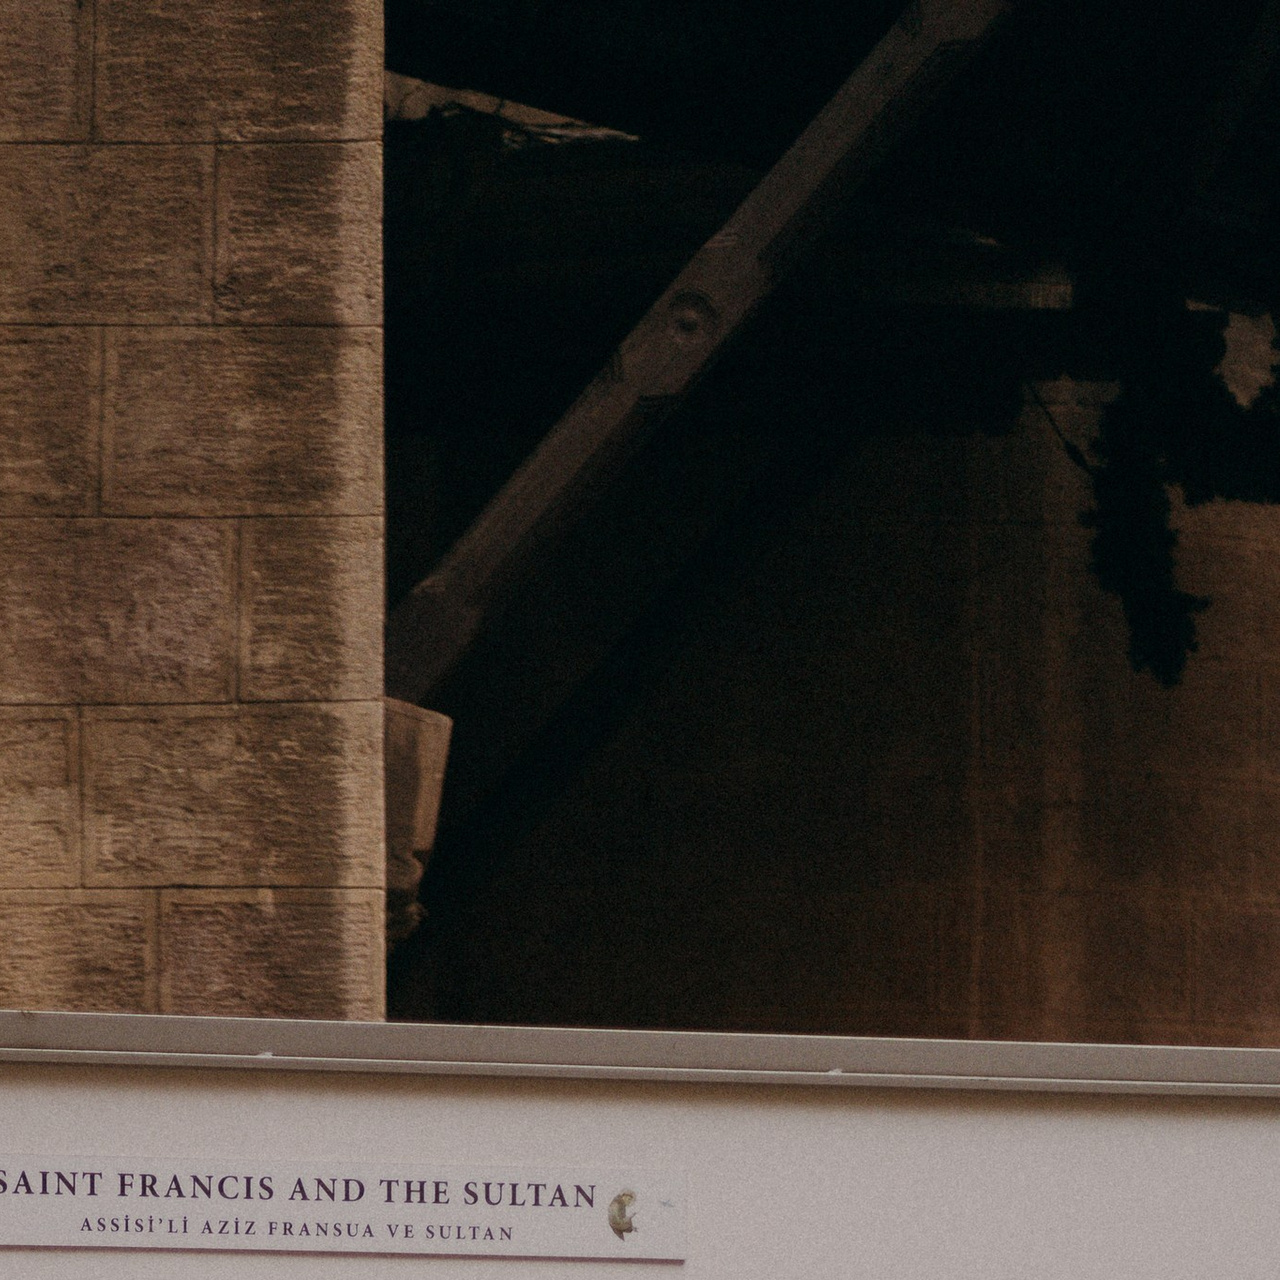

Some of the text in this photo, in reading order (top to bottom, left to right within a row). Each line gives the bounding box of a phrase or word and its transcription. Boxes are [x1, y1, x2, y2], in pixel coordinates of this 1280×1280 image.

[117, 1173, 274, 1200] FRANCIS
[288, 1177, 366, 1202] AND
[379, 1179, 451, 1204] THE
[463, 1181, 597, 1208] SULTAN
[201, 1217, 257, 1236] AZİZ
[268, 1221, 375, 1238] FRANSUA
[387, 1224, 414, 1239] VE
[425, 1225, 514, 1241] SULTAN
